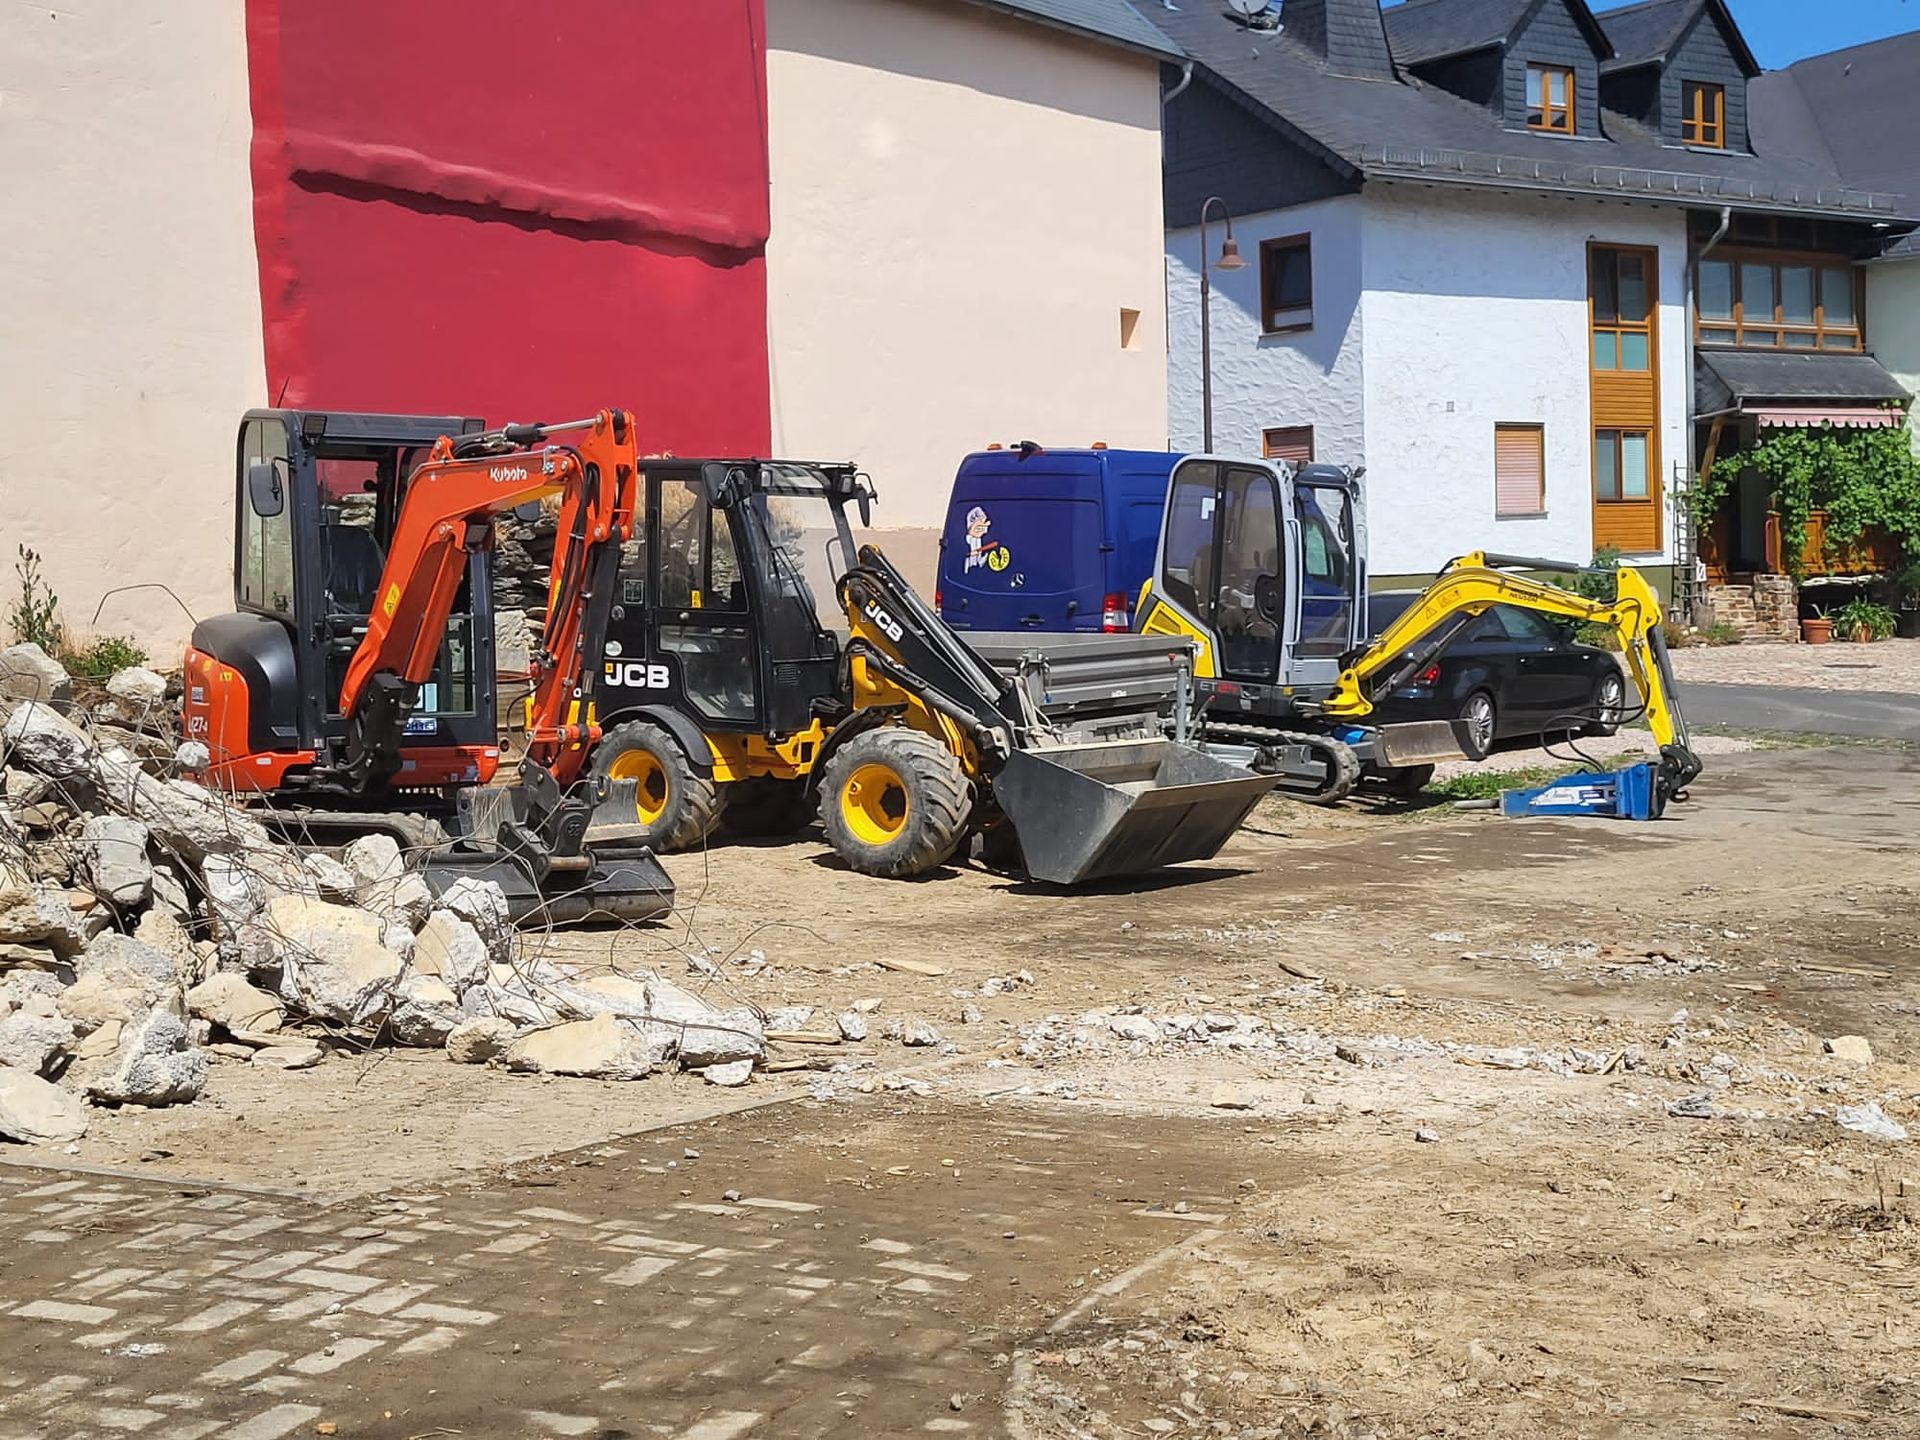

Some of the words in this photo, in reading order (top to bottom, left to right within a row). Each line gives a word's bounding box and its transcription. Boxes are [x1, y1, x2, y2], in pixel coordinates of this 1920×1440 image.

[490, 465, 527, 482] Kubota
[865, 600, 904, 643] JCB
[604, 663, 670, 689] JCB
